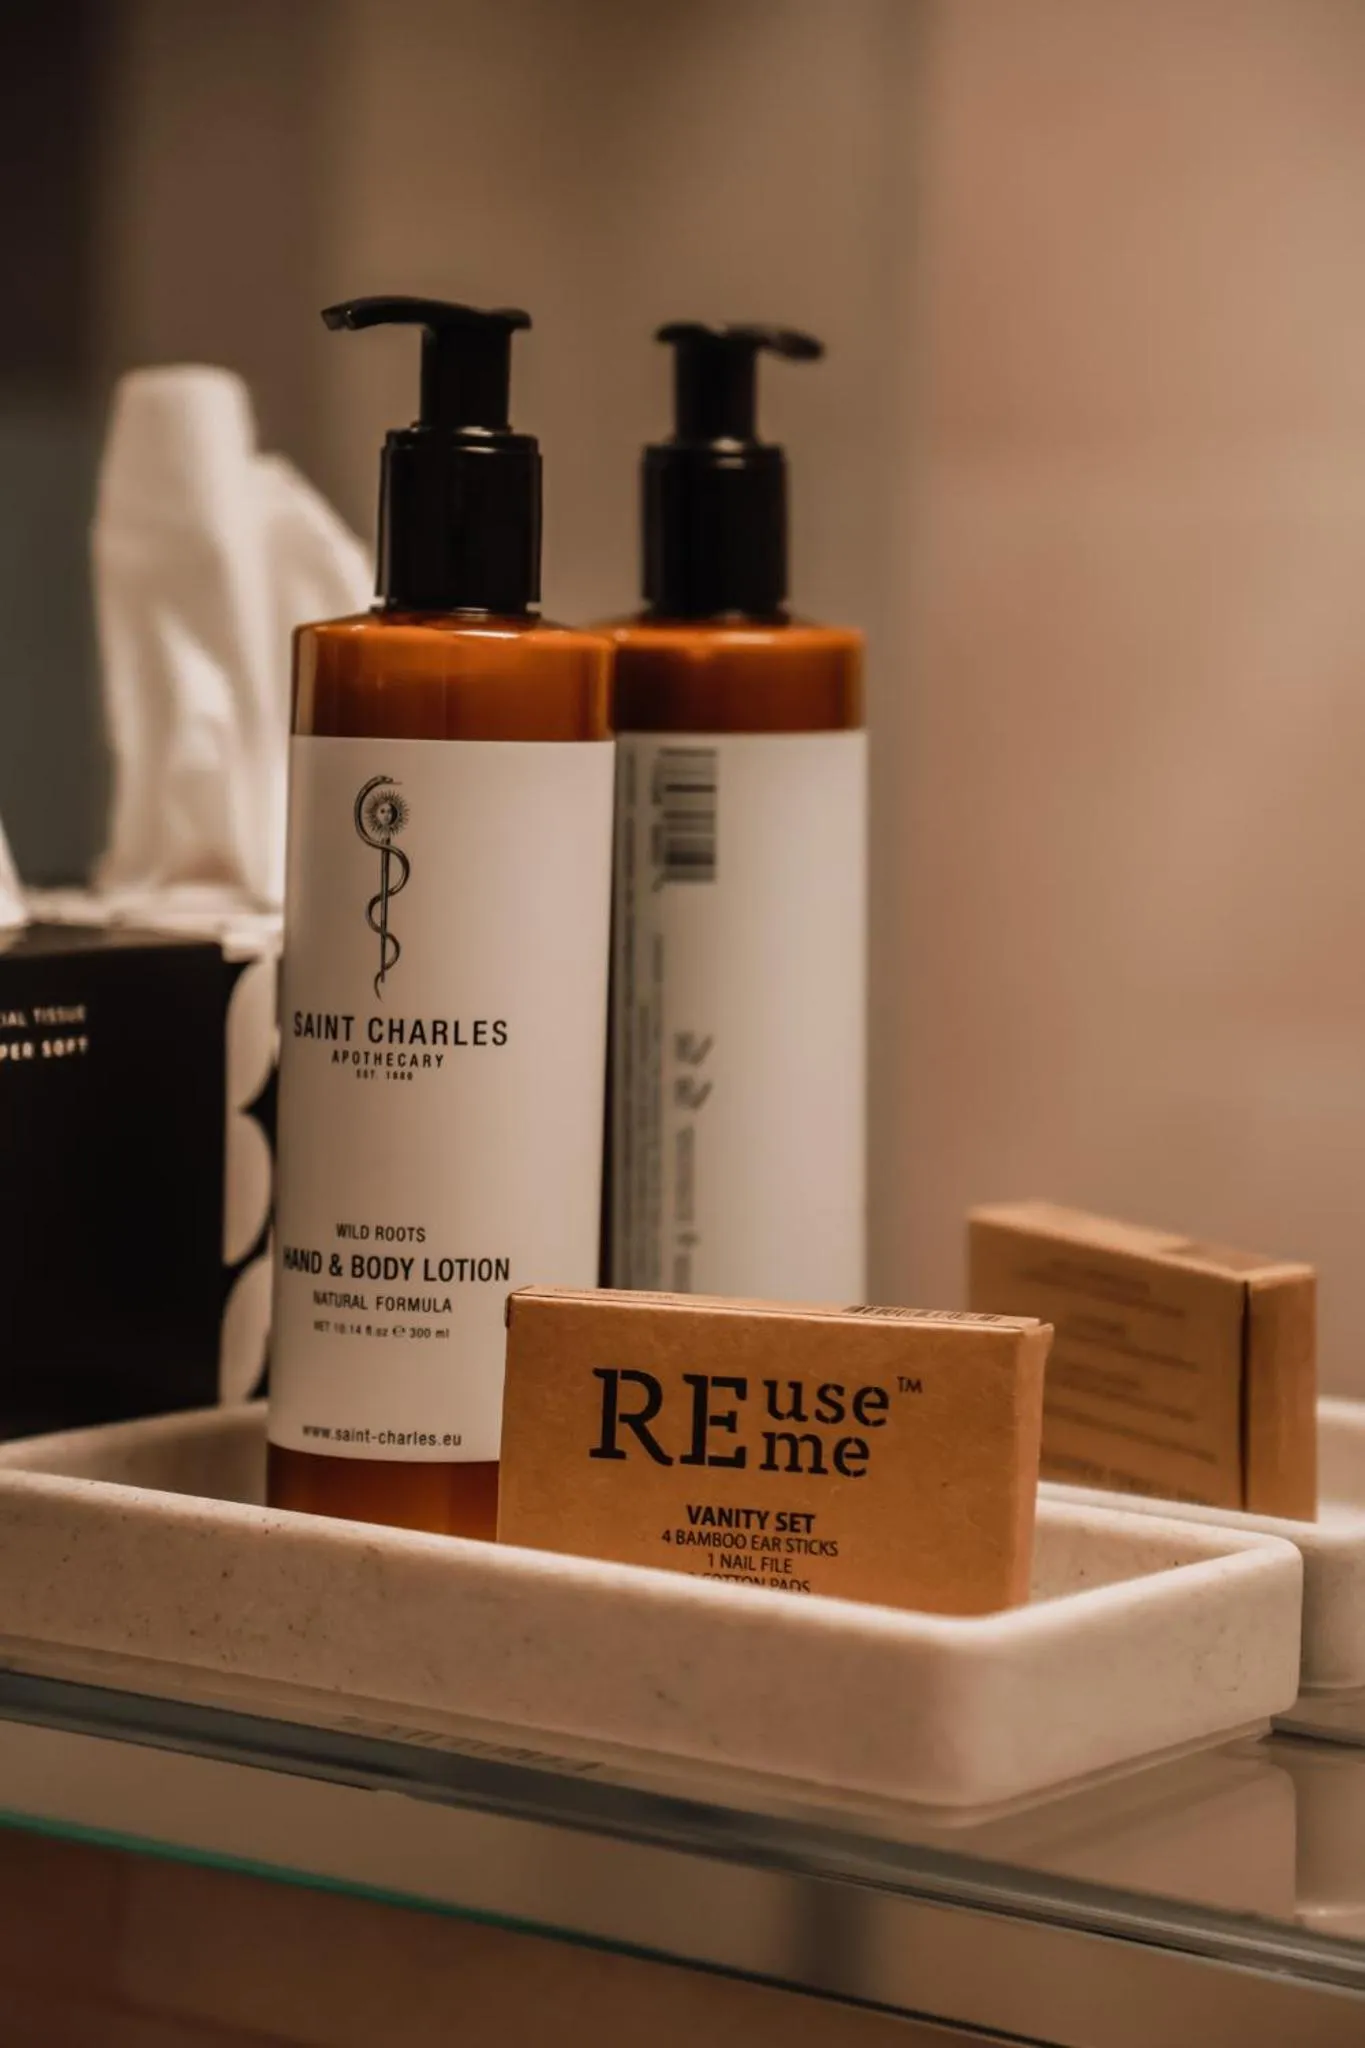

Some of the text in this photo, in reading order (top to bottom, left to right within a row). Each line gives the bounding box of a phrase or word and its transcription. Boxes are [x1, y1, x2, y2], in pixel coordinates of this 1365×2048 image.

[294, 1011, 508, 1046] SAINT CHARLES
[42, 1035, 88, 1057] SOFT
[331, 1050, 444, 1068] APOTHECARY
[336, 1223, 426, 1243] WILD ROOTS
[283, 1245, 510, 1282] HAND & BODY LOTION
[313, 1290, 453, 1313] NATURAL FORMULA
[409, 1327, 431, 1339] 300
[435, 1328, 449, 1339] ml
[303, 1424, 462, 1446] www.saint-charles.eu
[759, 1430, 870, 1478] me
[686, 1504, 816, 1534] VANITY SET
[662, 1529, 838, 1557] 4 BAMBOO EAR STICKS
[707, 1553, 793, 1574] 1 NAIL FILE
